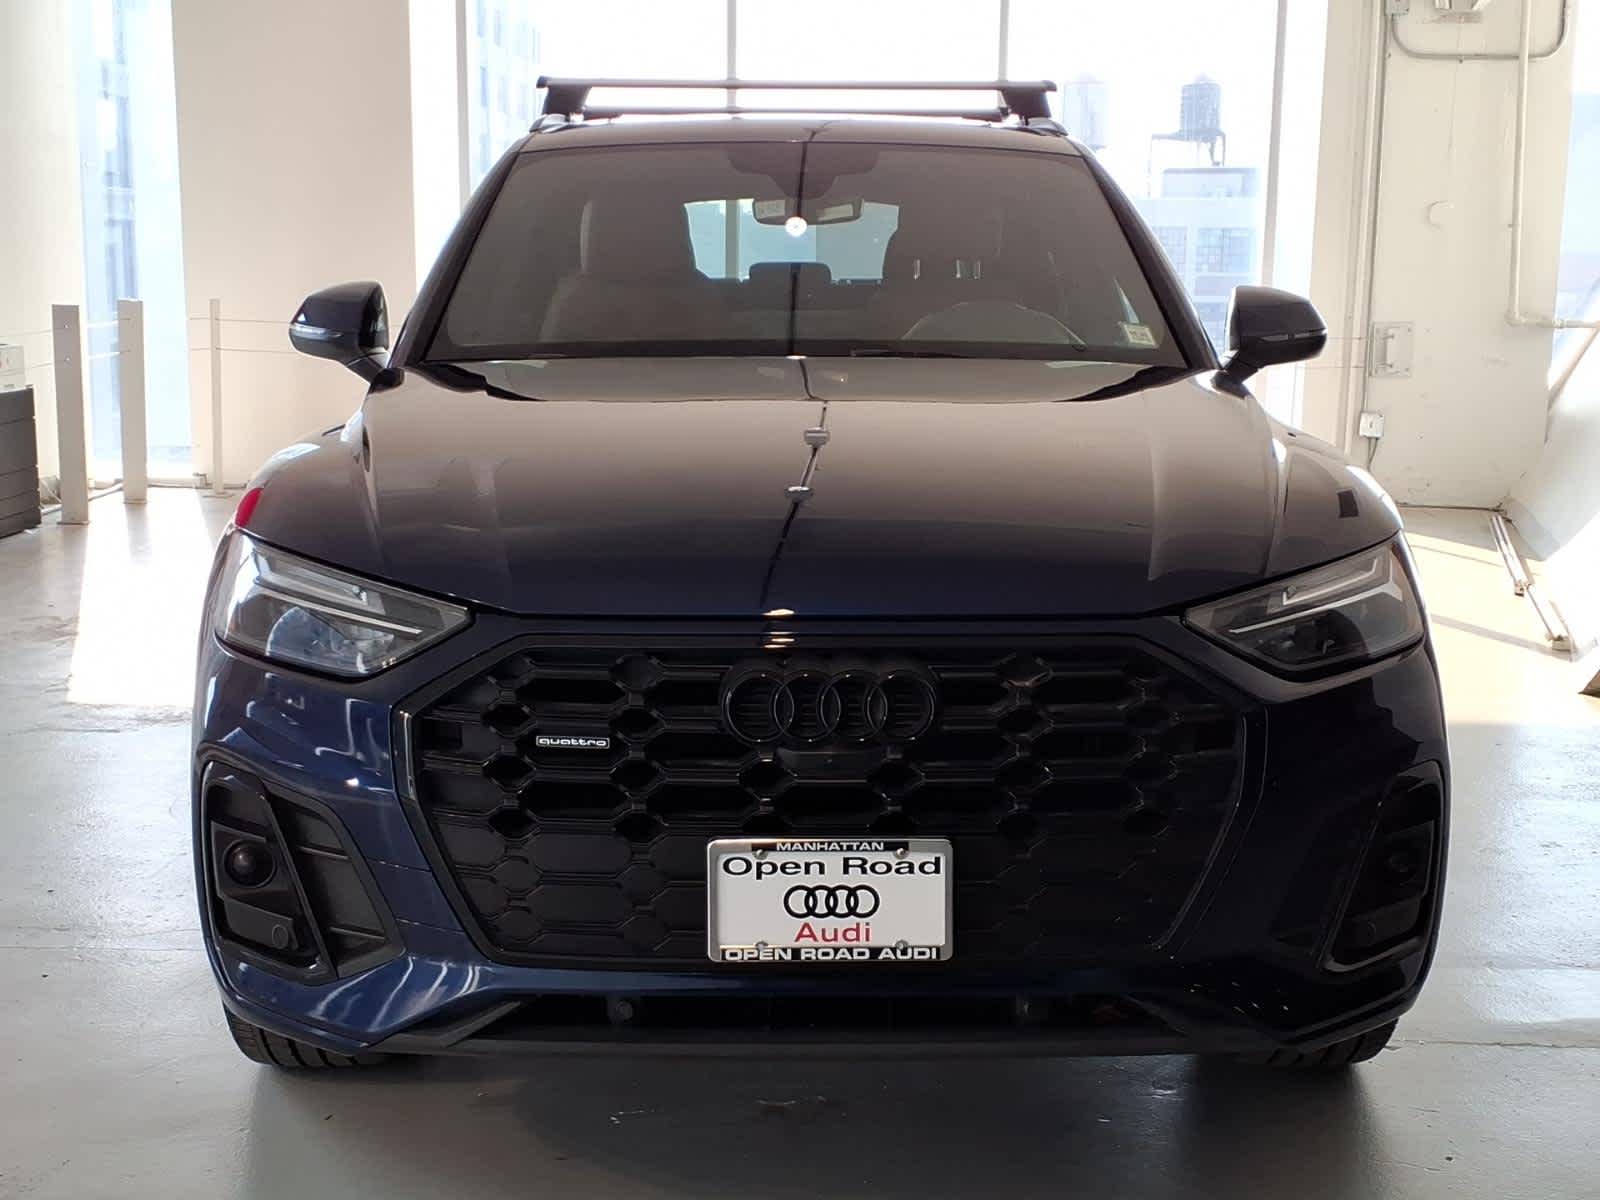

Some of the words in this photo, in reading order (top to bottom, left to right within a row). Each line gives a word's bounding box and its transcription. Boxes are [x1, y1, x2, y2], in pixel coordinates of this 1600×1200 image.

[539, 738, 607, 746] quattro
[776, 842, 884, 851] MANHATTAN
[722, 856, 826, 880] Open
[842, 856, 941, 875] Road
[794, 922, 871, 943] Audi
[725, 948, 792, 960] OPEN
[800, 948, 871, 960] ROAD
[878, 947, 937, 960] AUDI
